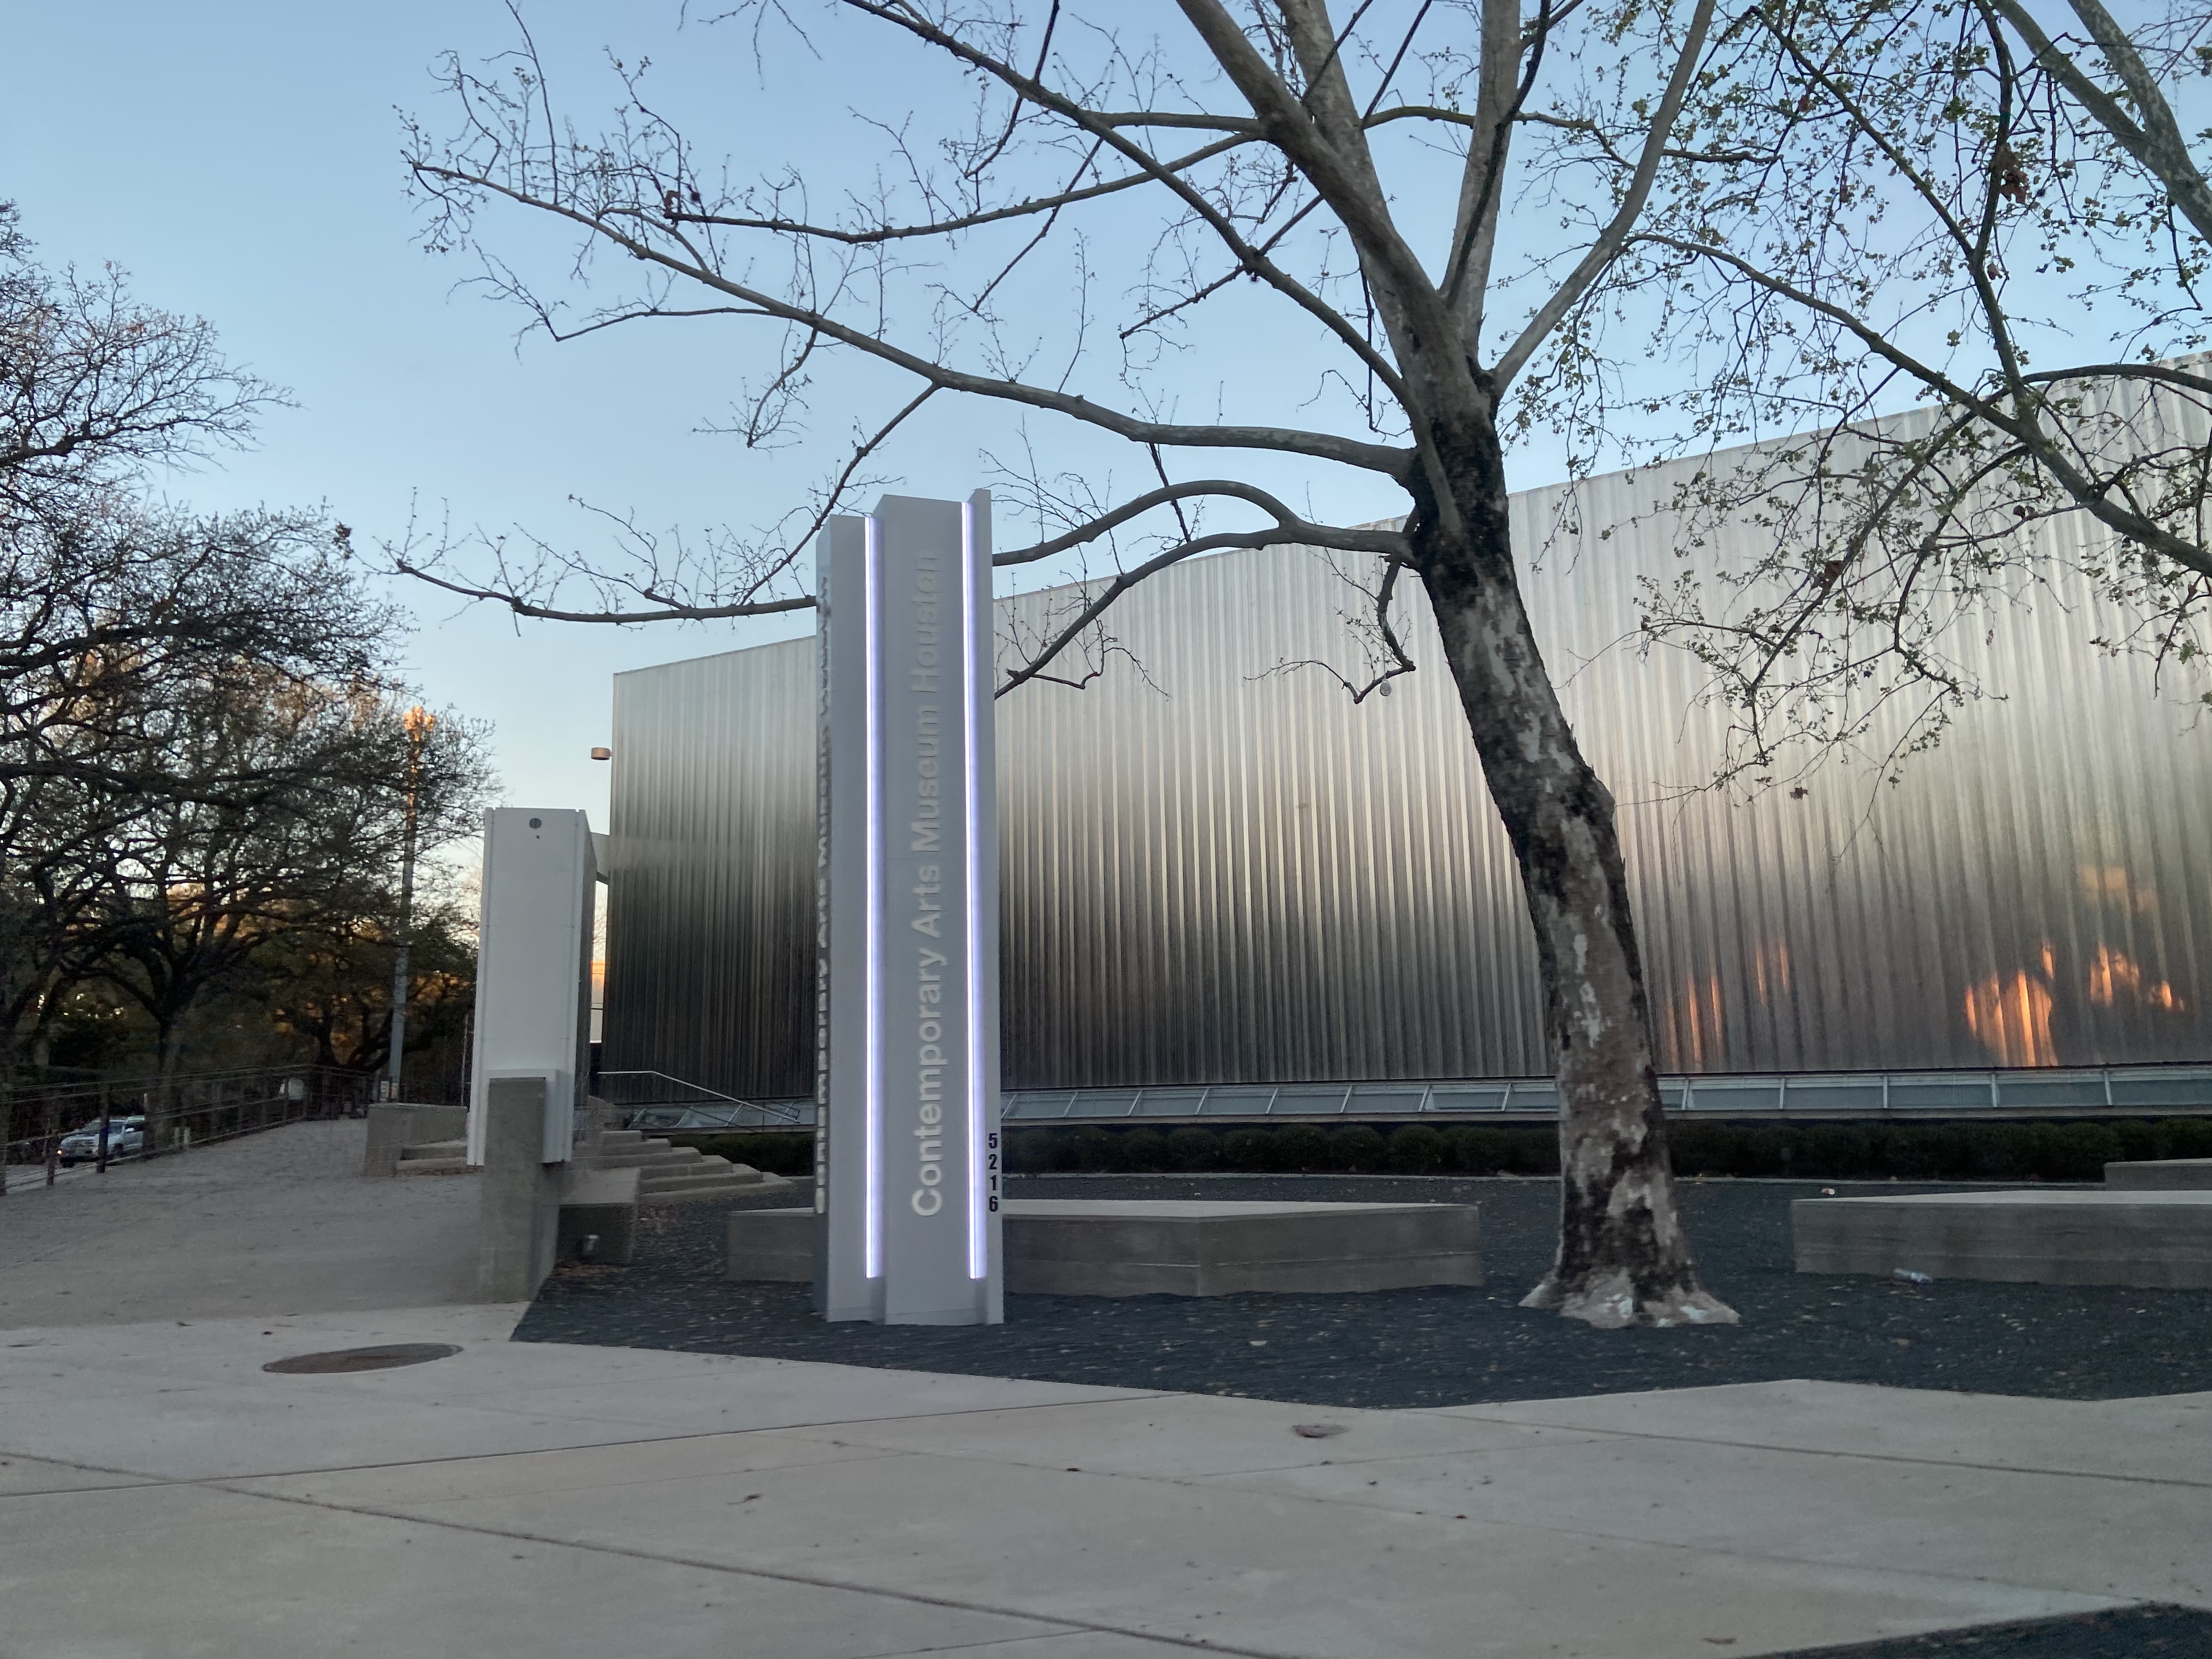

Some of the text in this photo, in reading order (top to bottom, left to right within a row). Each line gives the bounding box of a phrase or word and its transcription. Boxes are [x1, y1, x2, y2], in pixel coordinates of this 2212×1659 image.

[911, 556, 947, 1216] Contemporary Arts Museum Houston
[989, 1133, 998, 1212] 5216
